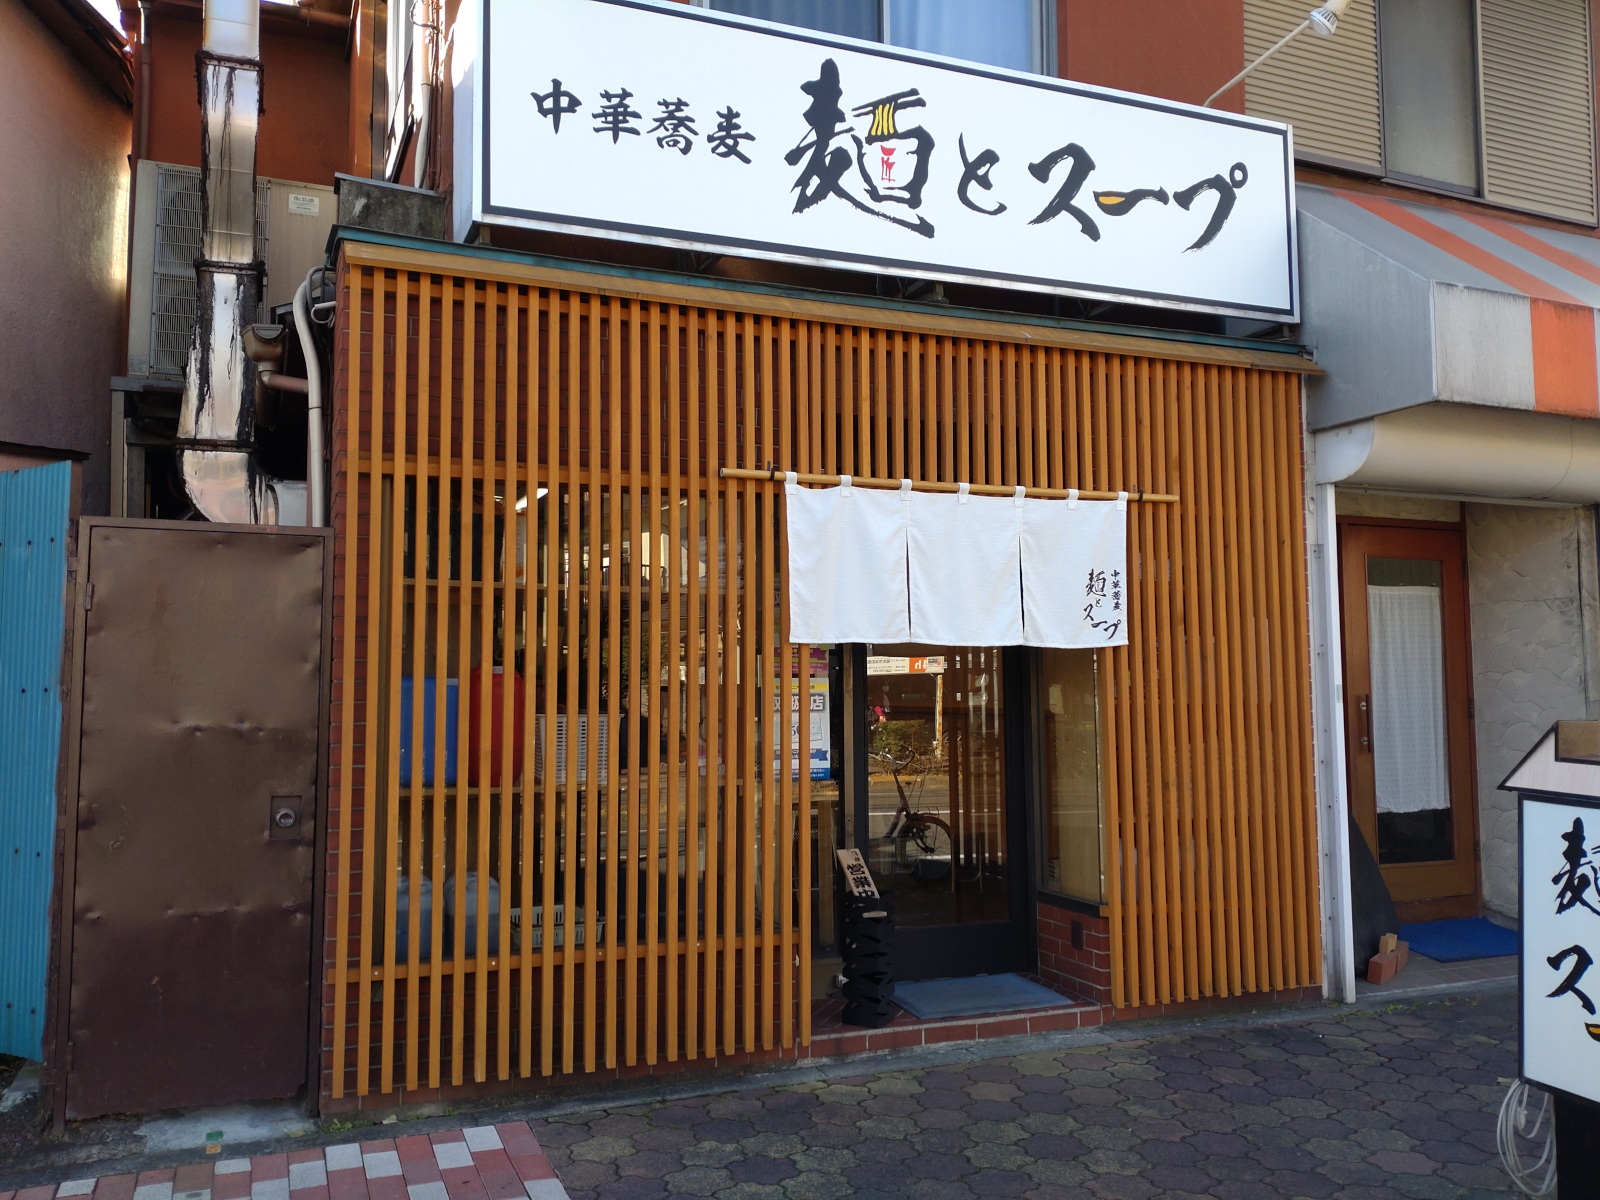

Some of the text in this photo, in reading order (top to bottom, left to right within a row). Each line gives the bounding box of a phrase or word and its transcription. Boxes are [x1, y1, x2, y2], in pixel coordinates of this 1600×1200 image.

[531, 58, 1248, 254] 中華蕎麦 麺とスープ
[1110, 569, 1123, 611] 中華蕎麦
